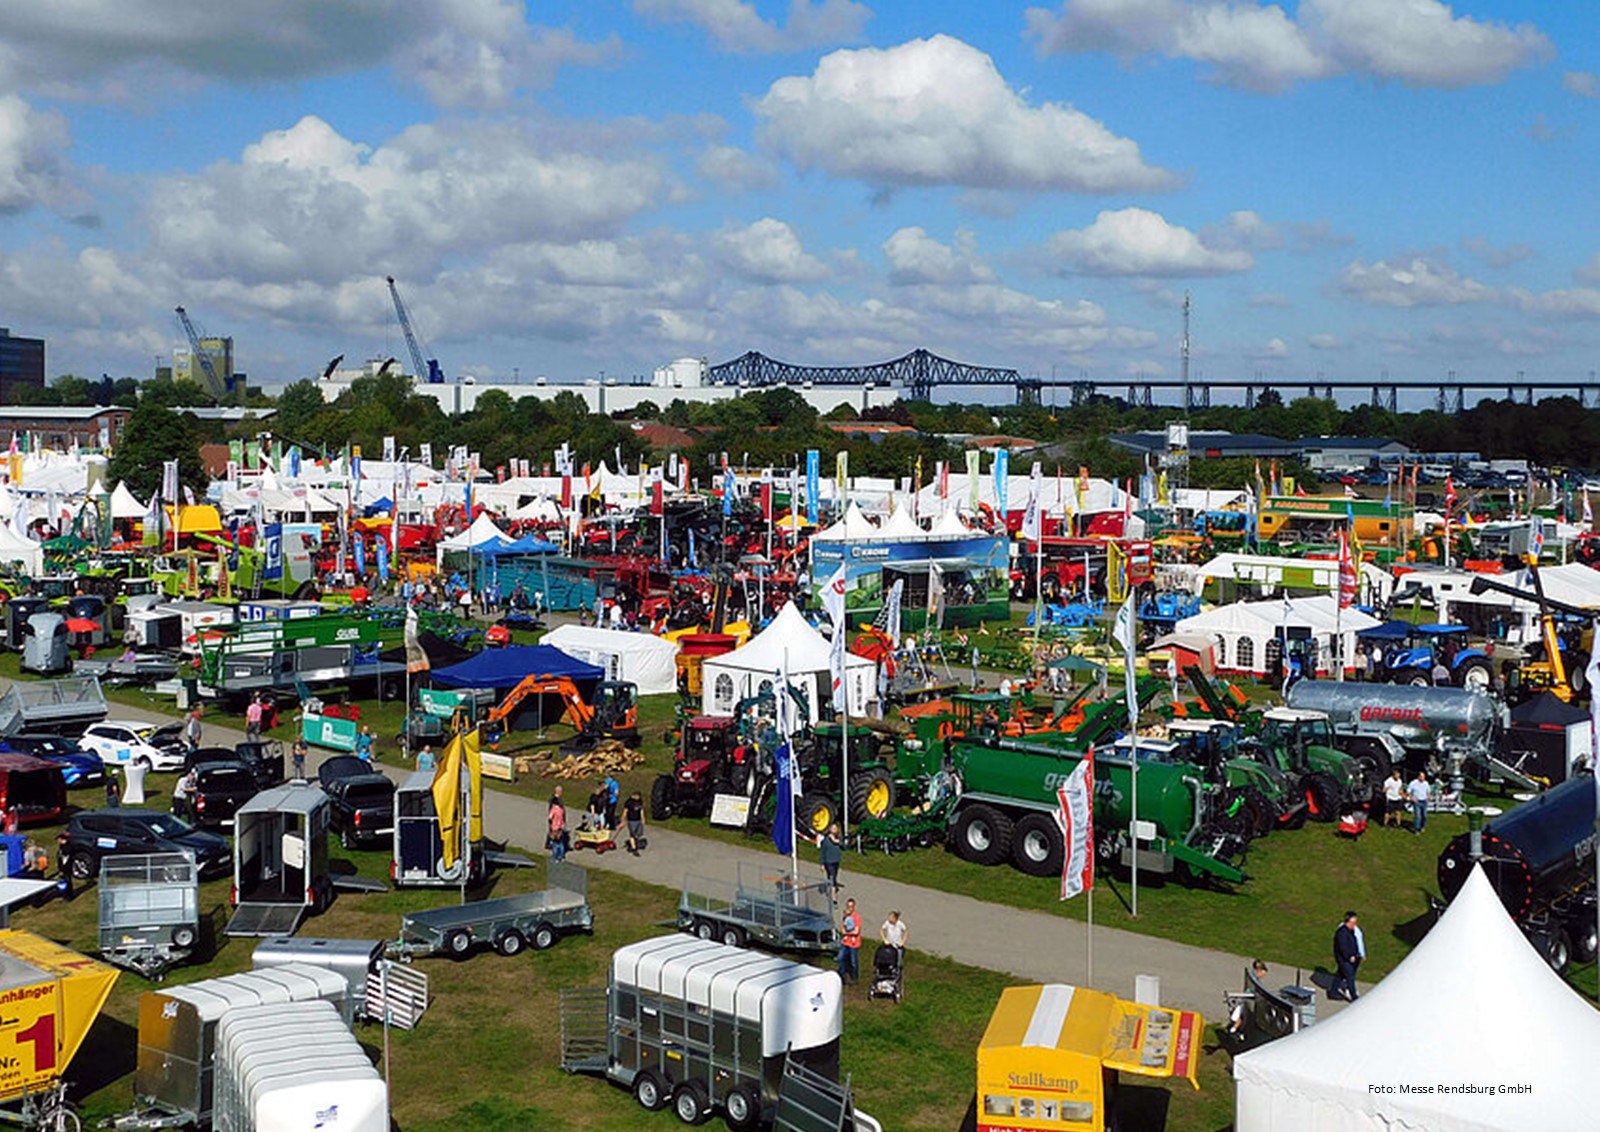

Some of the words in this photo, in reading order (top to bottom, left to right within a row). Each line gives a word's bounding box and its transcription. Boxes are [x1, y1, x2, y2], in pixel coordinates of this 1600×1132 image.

[1359, 705, 1423, 722] garant
[1043, 771, 1113, 796] gant
[0, 984, 55, 1005] nhänger
[16, 1013, 56, 1073] 1
[1008, 1071, 1079, 1094] Stallkamp
